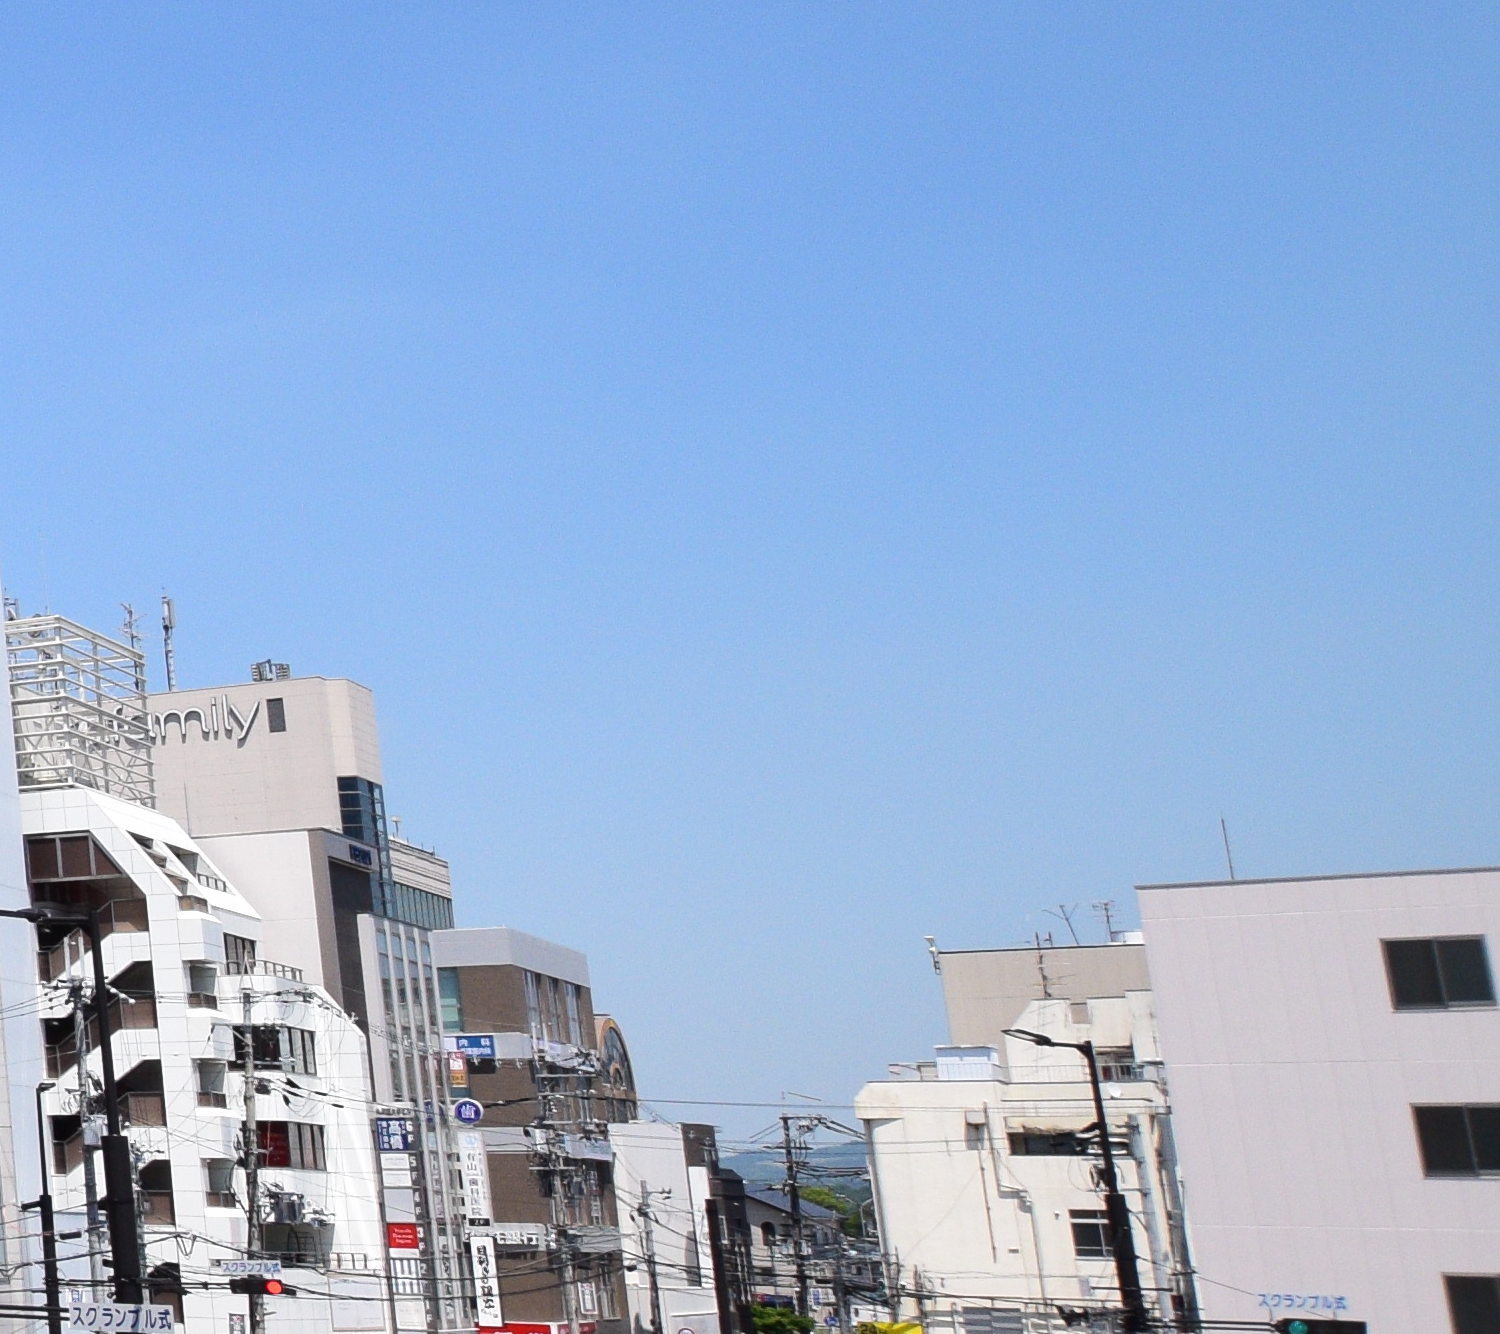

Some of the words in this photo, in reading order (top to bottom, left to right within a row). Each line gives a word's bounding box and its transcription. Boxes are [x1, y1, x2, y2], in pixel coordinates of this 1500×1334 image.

[1258, 1293, 1348, 1310] スクランブル式
[73, 1307, 172, 1330] スクランブル式
